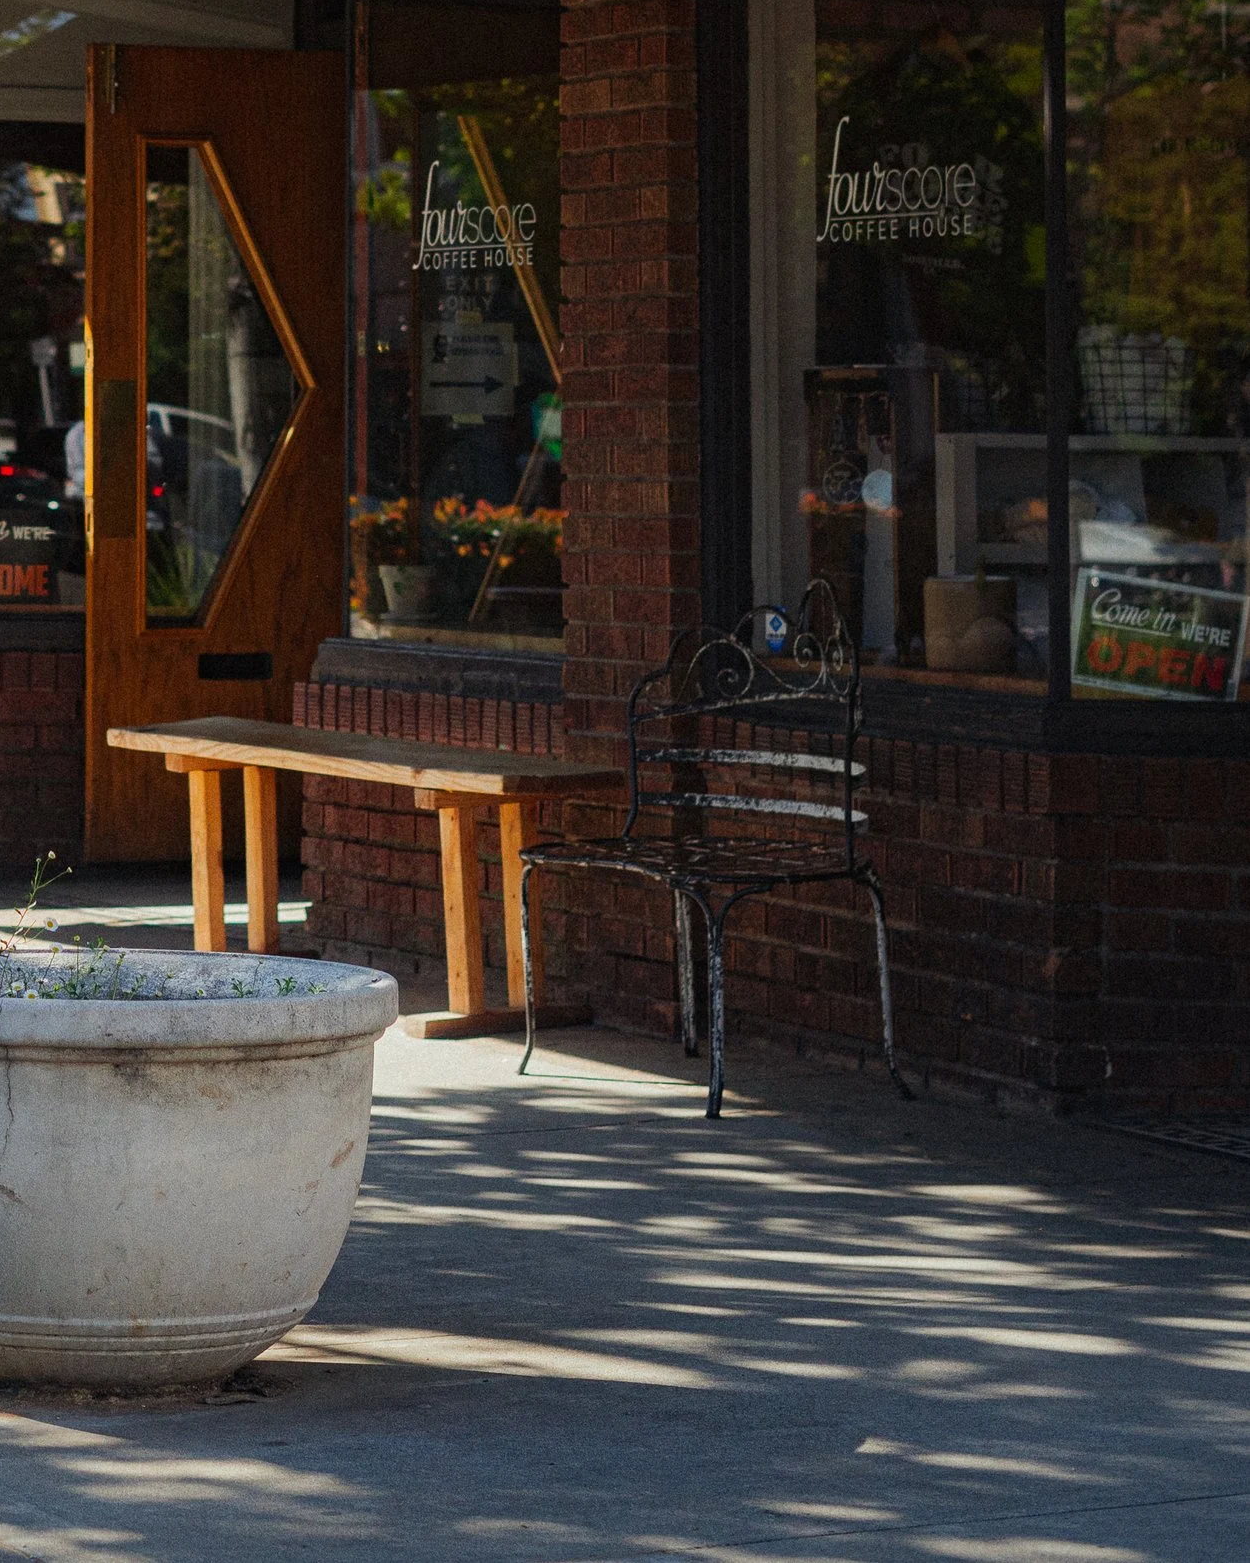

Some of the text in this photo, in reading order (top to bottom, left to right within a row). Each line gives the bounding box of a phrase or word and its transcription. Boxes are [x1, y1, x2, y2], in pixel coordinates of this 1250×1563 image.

[817, 116, 976, 242] fourscore
[412, 160, 537, 270] fourscore
[830, 214, 973, 242] COFFEE HOUSE
[423, 247, 534, 270] COFFEE HOUSE
[12, 525, 51, 541] WE'RE
[1091, 588, 1232, 647] Come in WE'RE
[1086, 634, 1227, 691] OPEN
